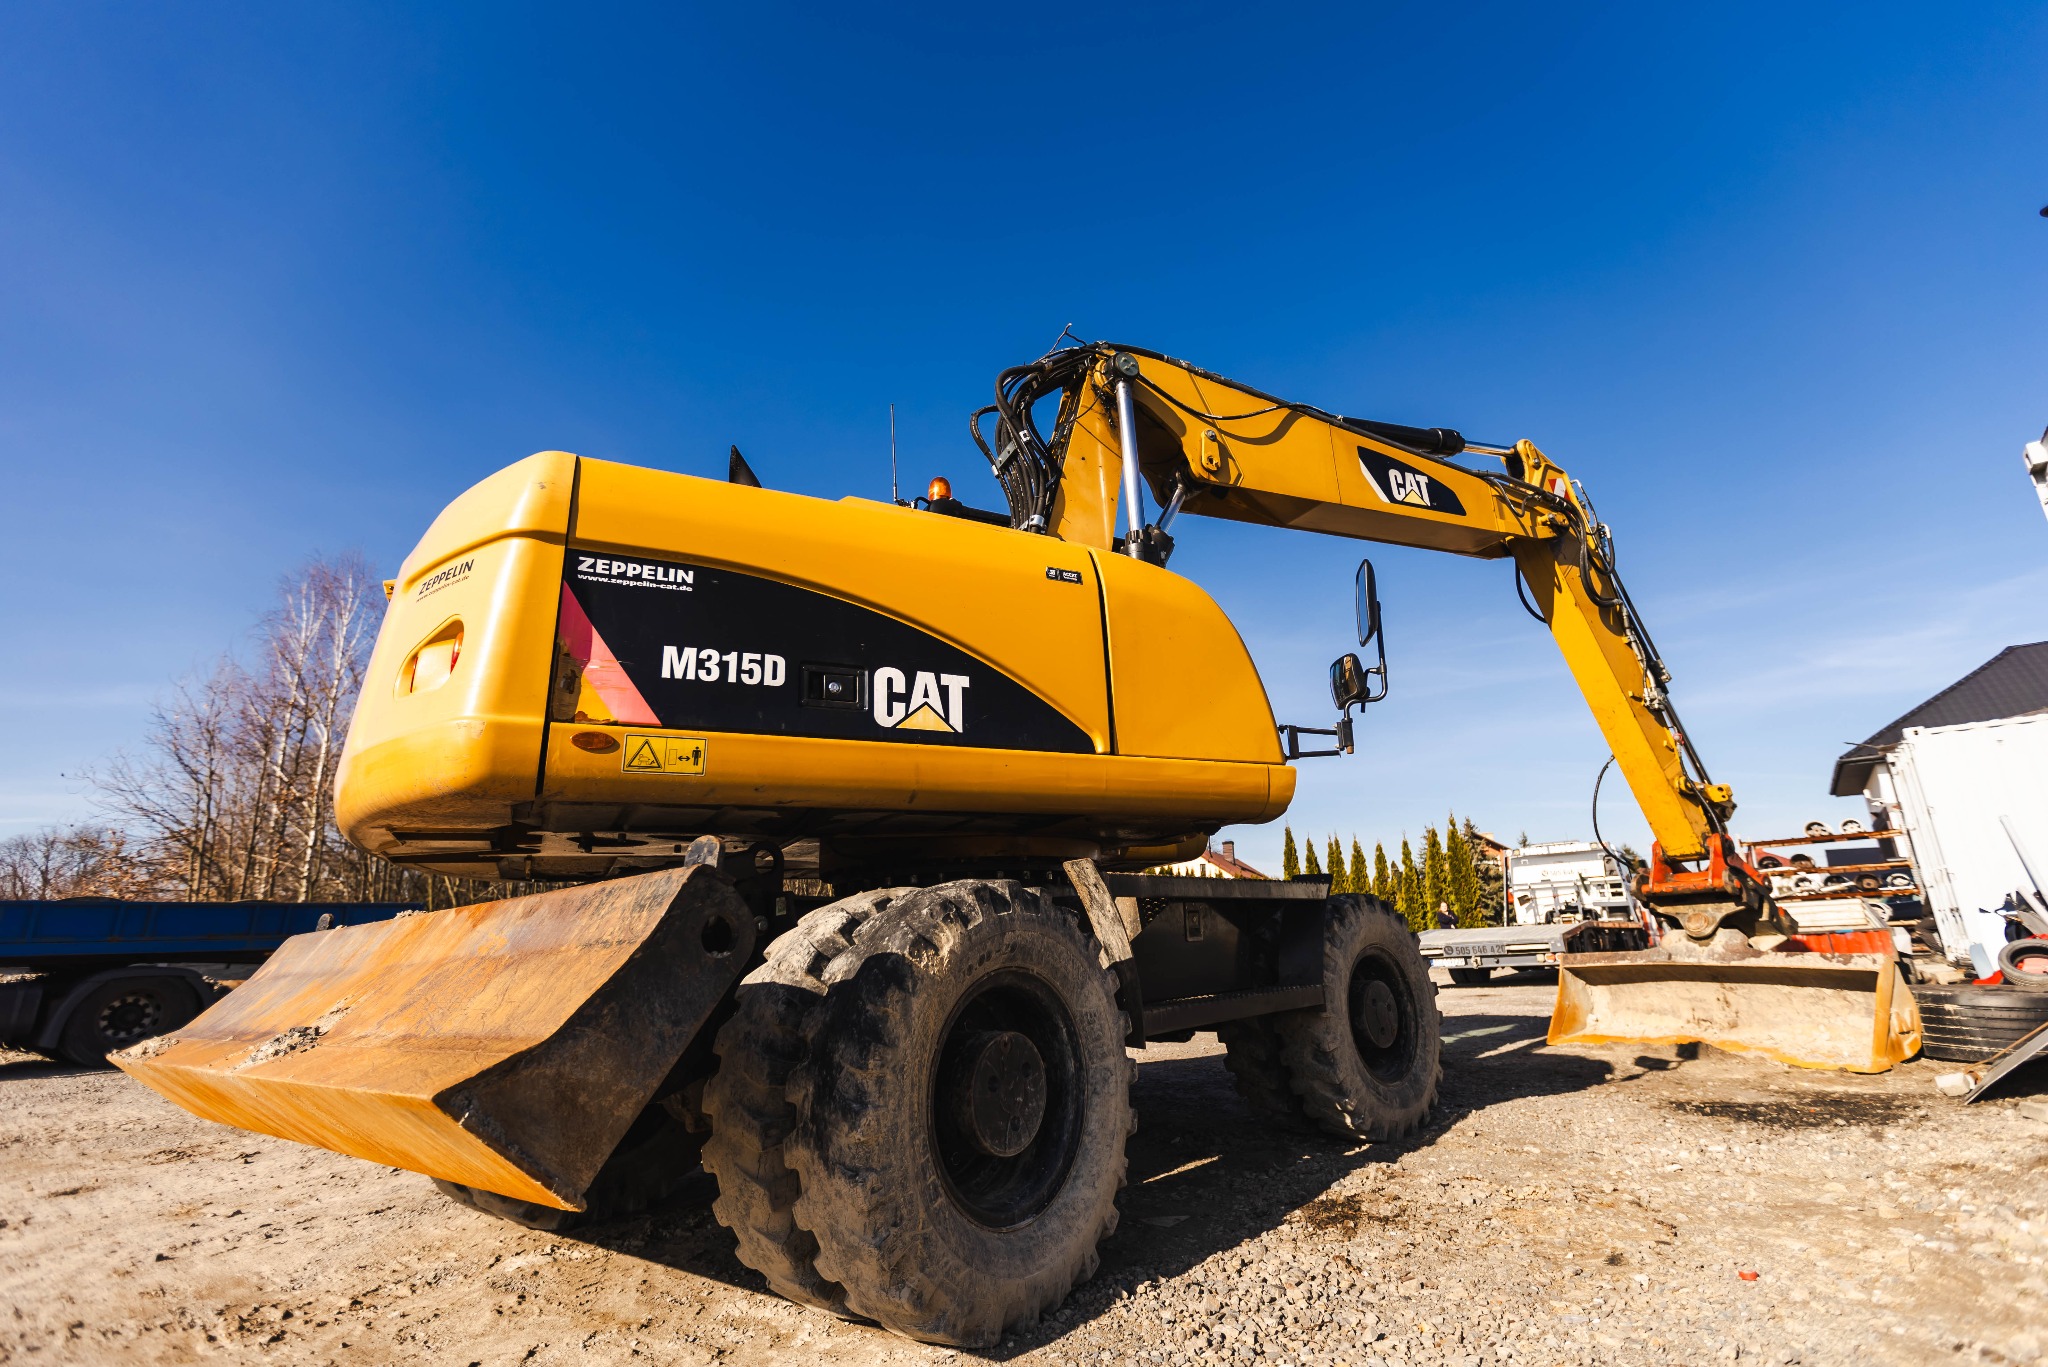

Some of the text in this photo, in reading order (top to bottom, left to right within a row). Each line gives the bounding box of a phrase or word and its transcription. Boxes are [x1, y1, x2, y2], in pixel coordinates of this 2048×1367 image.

[1388, 468, 1431, 507] CAT
[418, 558, 475, 596] ZEPPELIN
[577, 556, 694, 584] ZEPPELIN
[577, 574, 693, 592] www.zeppelin-cat.de
[661, 645, 786, 687] M315D
[873, 666, 970, 733] CAT
[1455, 946, 1471, 955] 505
